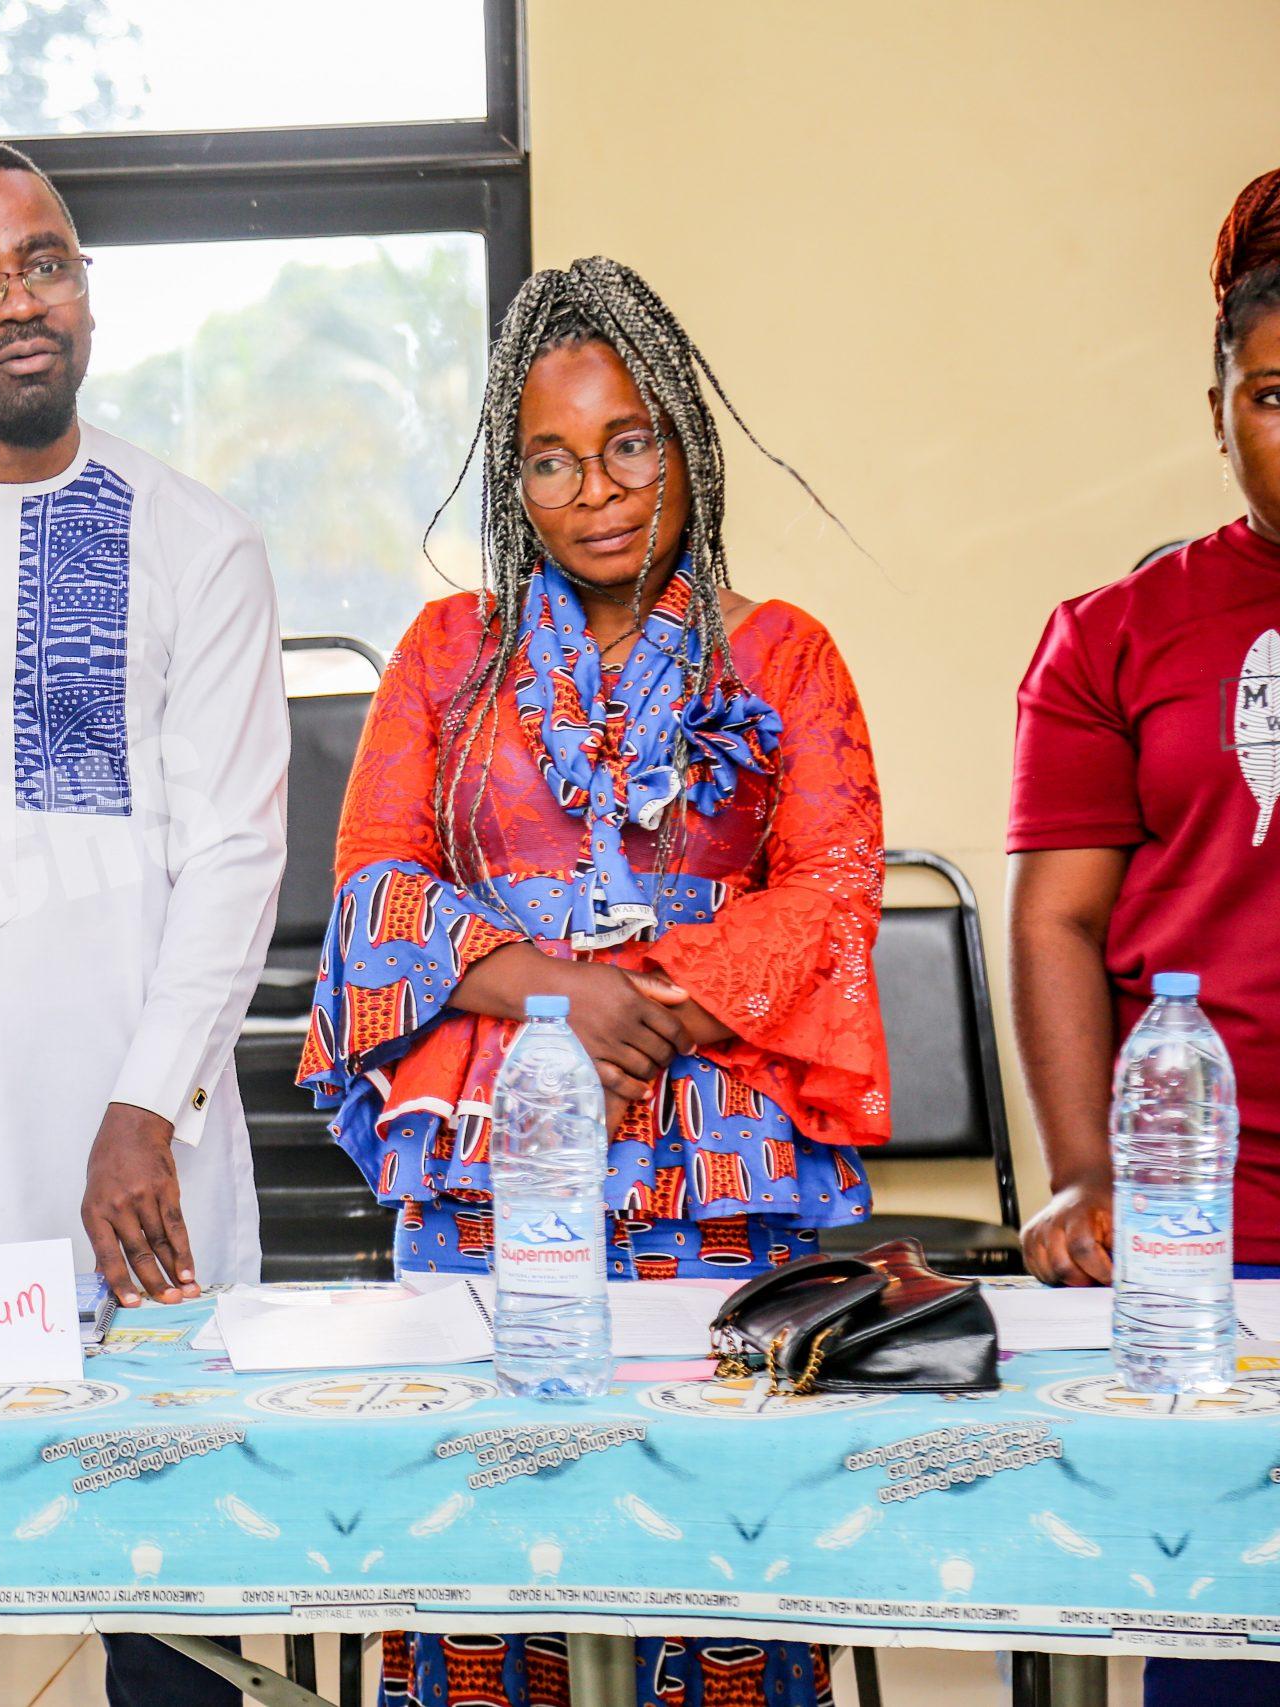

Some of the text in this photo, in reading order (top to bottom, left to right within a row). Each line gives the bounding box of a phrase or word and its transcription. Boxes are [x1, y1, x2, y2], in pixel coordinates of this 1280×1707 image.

[500, 1243, 591, 1265] Supermont
[1132, 1235, 1226, 1259] Supermont
[137, 1432, 170, 1449] Care
[180, 1430, 245, 1456] Assisting
[437, 1434, 473, 1459] Love
[517, 1438, 533, 1454] to
[535, 1429, 569, 1446] Care
[579, 1427, 646, 1453] Assisting
[886, 1430, 955, 1459] Christian
[42, 1439, 79, 1463] Love
[100, 1447, 118, 1467] all
[119, 1441, 135, 1457] to
[164, 1447, 180, 1464] in
[478, 1450, 496, 1466] as
[497, 1443, 516, 1463] all
[539, 1449, 561, 1468] the
[562, 1443, 578, 1461] in
[947, 1442, 983, 1462] Care
[82, 1453, 98, 1470] as
[140, 1451, 162, 1471] the
[847, 1447, 885, 1472] Love
[909, 1457, 928, 1478] all
[929, 1452, 946, 1469] to
[73, 1462, 139, 1493] Provision
[470, 1458, 538, 1490] Provision
[879, 1441, 1062, 1503] Assisting in the Provision
[888, 1463, 907, 1479] as
[14, 1590, 50, 1602] HEALTH
[50, 1590, 111, 1603] CONVENTION
[112, 1590, 151, 1603] BAPTIST
[152, 1590, 205, 1603] CAMEROON
[242, 1589, 472, 1603] CAMEROON BAPTIST CONVENTION HEALTH BOARD
[508, 1589, 740, 1608] CAMEROON BAPTIST CONVENTION HEALTH BOARD
[304, 1607, 404, 1620] VERITABLE WAX 1950
[779, 1598, 1020, 1622] CAMEROON BAPTIST CONVENTION HEALTH BOARD
[1060, 1610, 1094, 1625] BOARD
